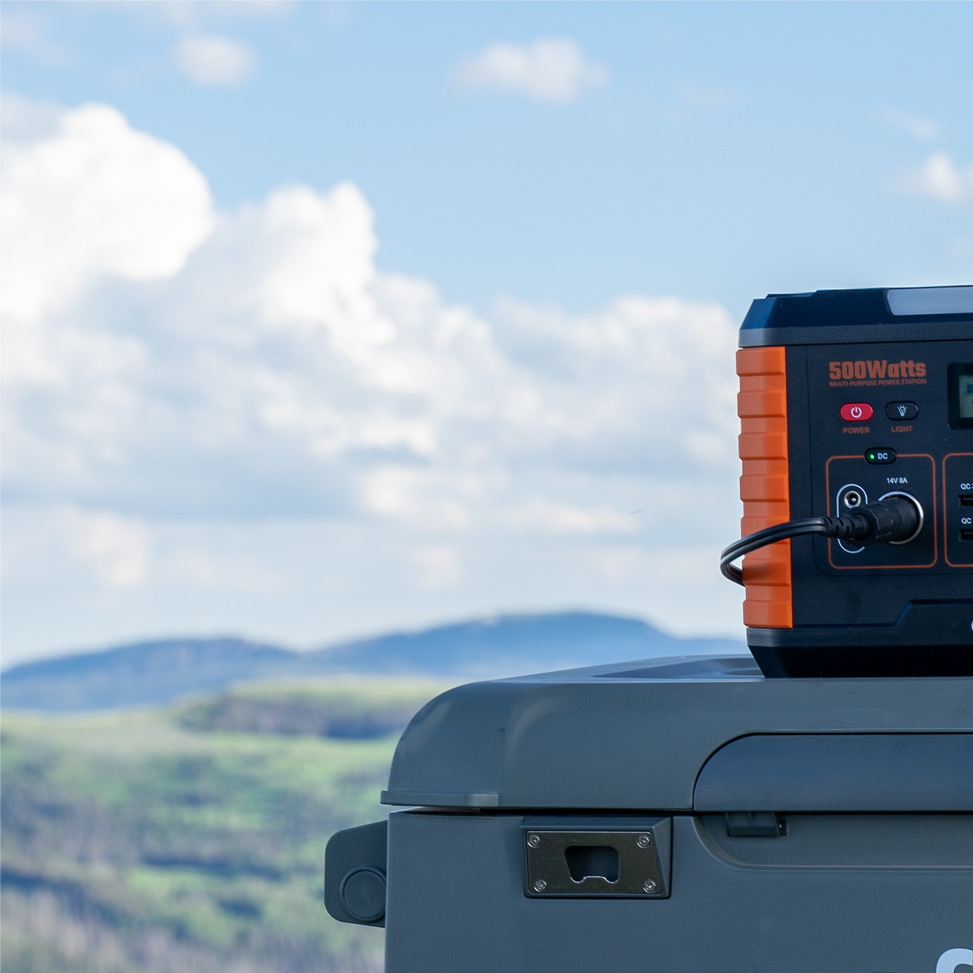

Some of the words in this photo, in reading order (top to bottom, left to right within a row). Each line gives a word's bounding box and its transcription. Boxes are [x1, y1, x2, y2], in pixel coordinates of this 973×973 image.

[829, 360, 926, 380] 500Watts
[843, 426, 870, 434] POWER
[891, 425, 913, 433] LIGHT
[877, 452, 889, 460] DC
